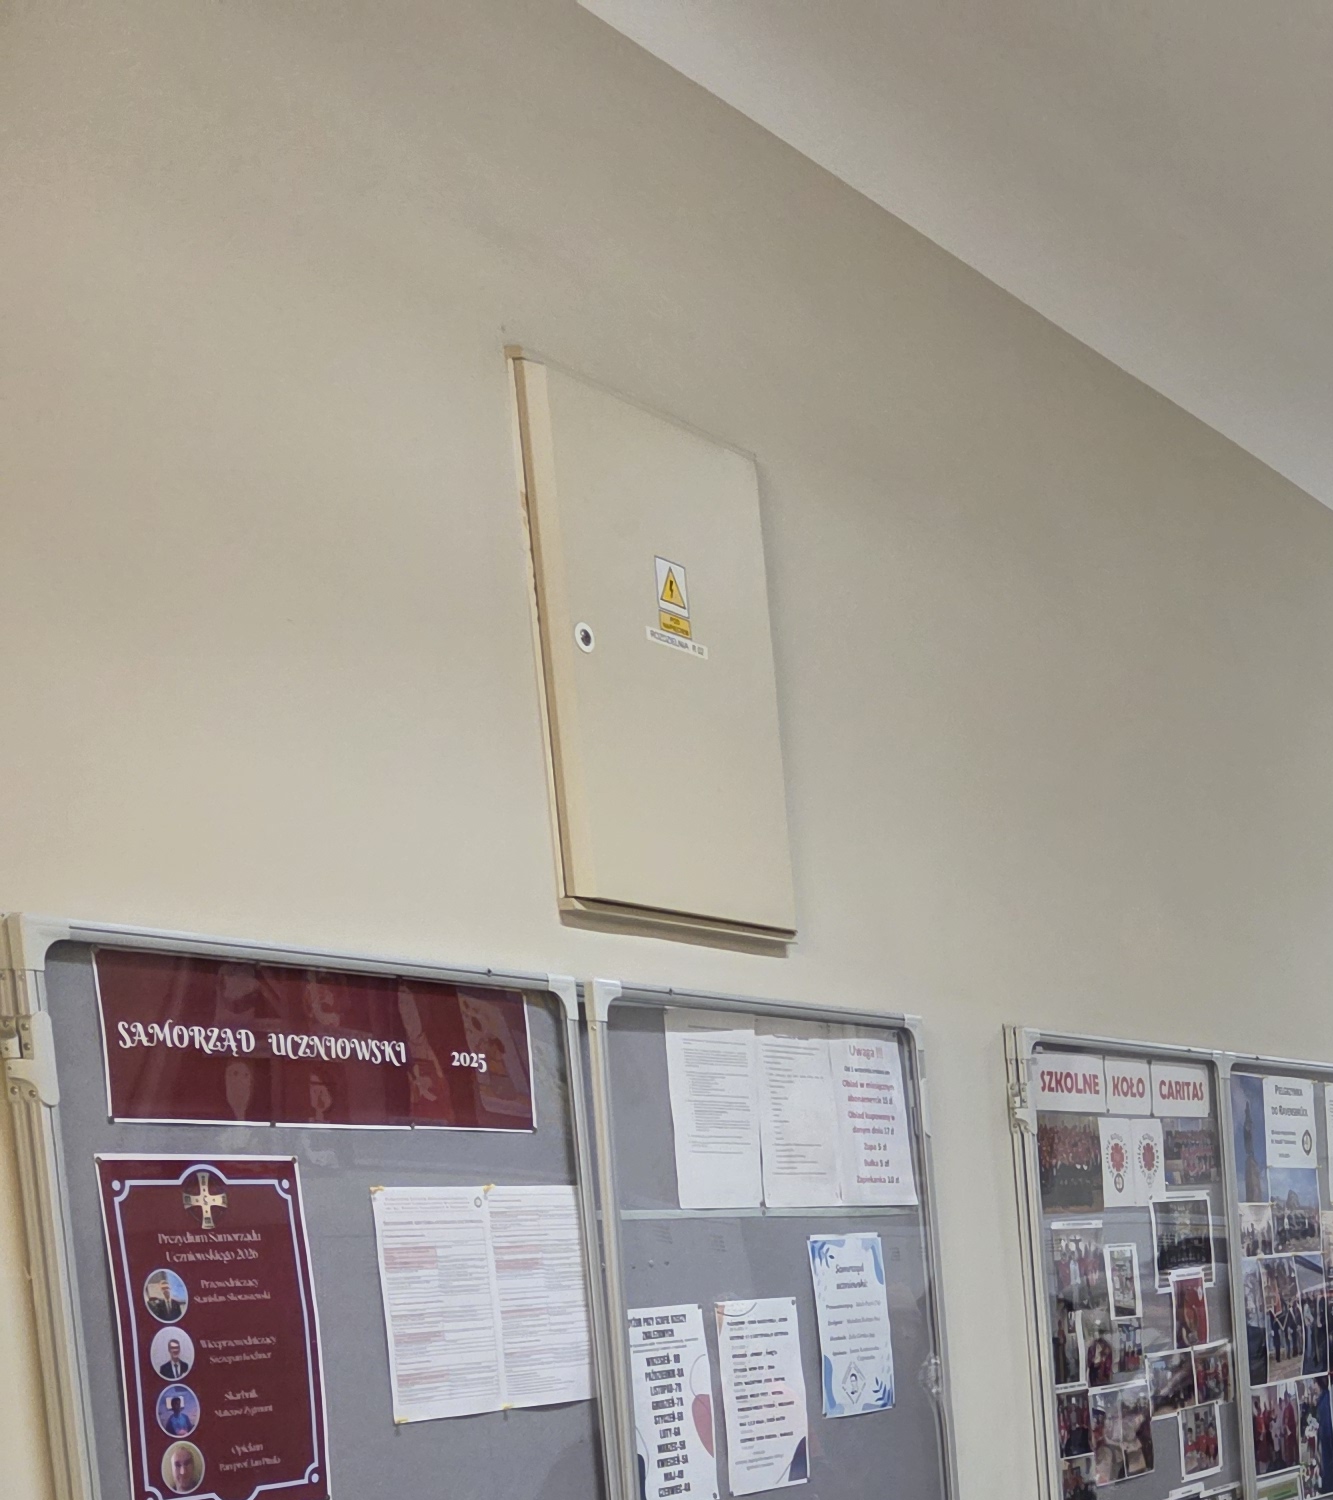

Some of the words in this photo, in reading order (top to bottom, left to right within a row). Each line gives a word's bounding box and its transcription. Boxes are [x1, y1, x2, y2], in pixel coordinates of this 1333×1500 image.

[117, 1019, 256, 1057] SAMORZĄD
[267, 1032, 407, 1067] UCZNIOWSKI
[450, 1050, 488, 1073] 2025
[849, 1045, 875, 1060] Uwaga
[1040, 1069, 1100, 1096] SZKOLNE
[1111, 1074, 1146, 1099] KOŁO
[1158, 1079, 1205, 1102] CARITAS
